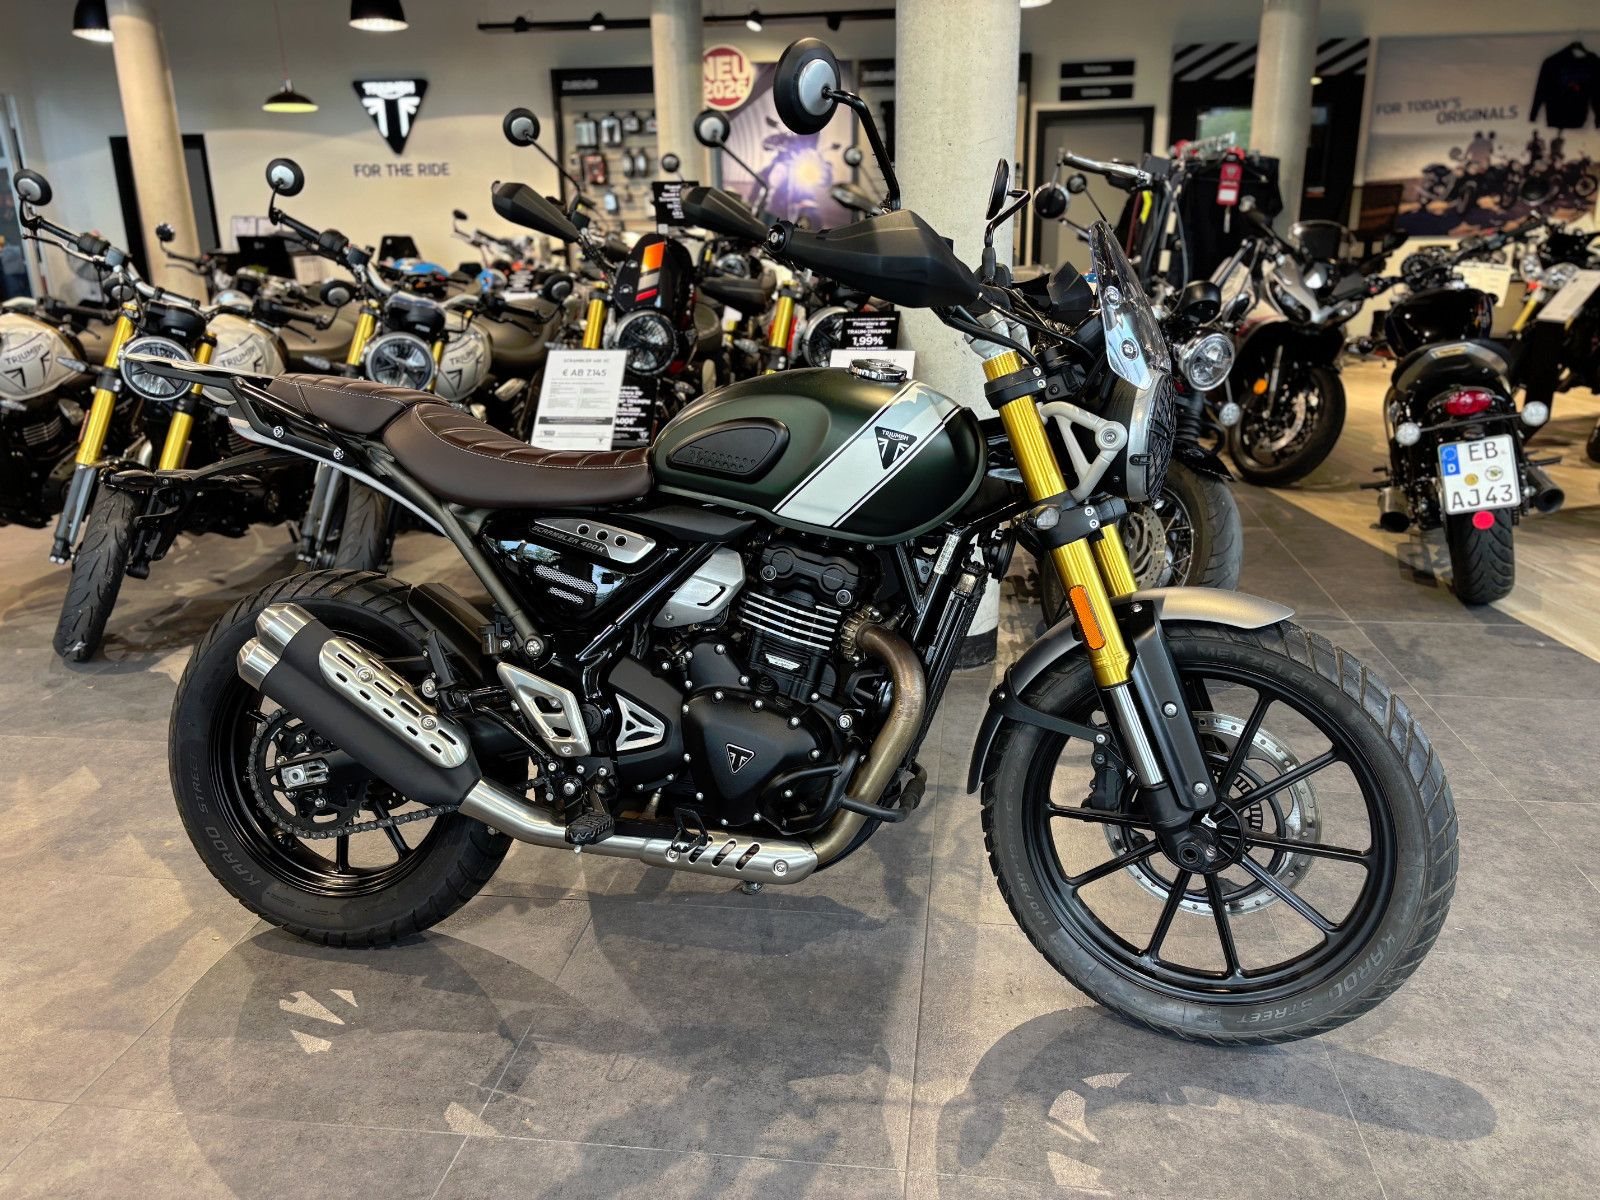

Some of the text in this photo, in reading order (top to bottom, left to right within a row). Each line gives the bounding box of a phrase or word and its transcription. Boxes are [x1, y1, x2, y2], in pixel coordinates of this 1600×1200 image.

[1376, 97, 1461, 114] FOR TODAY'S
[1437, 105, 1519, 124] ORIGINALS
[354, 162, 450, 177] FOR THE RIDE
[852, 336, 884, 346] 1,99%
[882, 429, 909, 441] TRIUMPH
[1468, 441, 1499, 462] EB
[1447, 463, 1456, 473] D
[1452, 484, 1513, 509] AJ 43
[532, 526, 578, 544] SCRAMBLER
[204, 826, 262, 887] KAROO
[1327, 928, 1397, 1001] KAROO
[1236, 997, 1314, 1025] STREET
